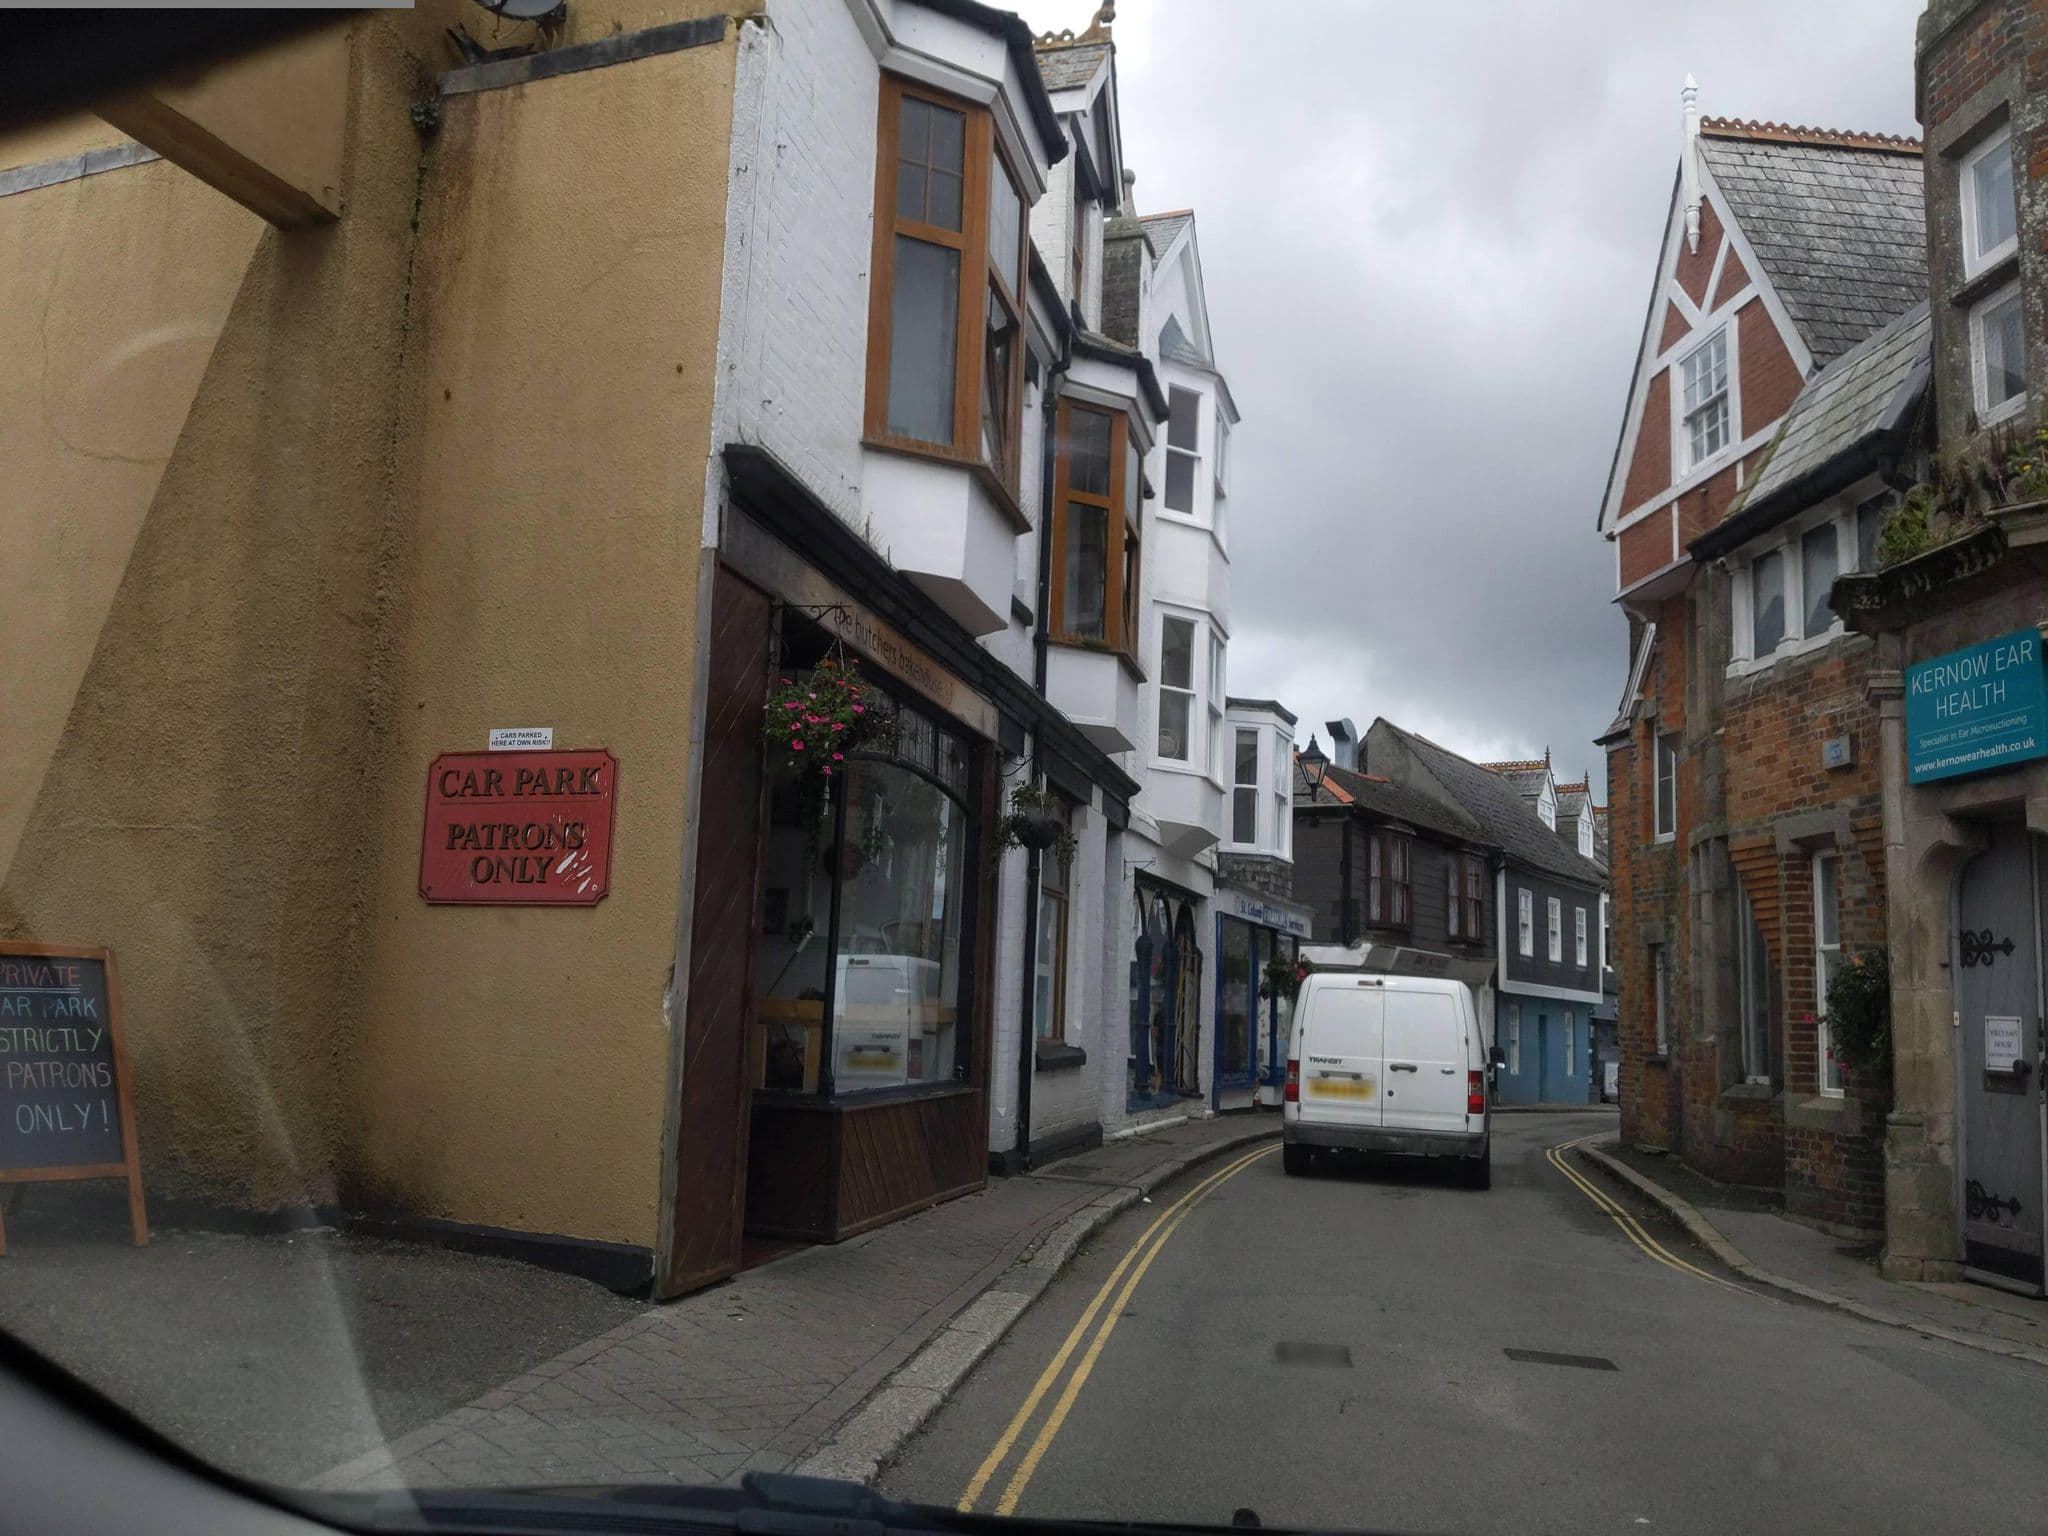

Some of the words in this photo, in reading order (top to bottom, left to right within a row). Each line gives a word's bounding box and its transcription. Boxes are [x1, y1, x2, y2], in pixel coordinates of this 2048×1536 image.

[855, 614, 897, 666] butchers
[1912, 653, 1989, 696] KERNOW
[1995, 639, 2033, 672] EAR
[1936, 679, 2006, 719] HEALTH
[1920, 733, 1949, 751] Specialist
[1950, 732, 1958, 740] in
[1958, 728, 1969, 739] Ear
[1970, 714, 2028, 736] Microsuctioning
[1914, 736, 2035, 773] www.kernowearhealth.co.uk
[439, 769, 504, 798] CAR
[513, 766, 601, 797] PARK
[446, 822, 586, 851] PATRONS
[471, 856, 554, 884] ONLY
[0, 997, 32, 1017] AR
[43, 996, 98, 1018] PARK
[0, 1027, 102, 1052] STRICTLY
[7, 1061, 112, 1089] PATRONS
[1308, 1056, 1344, 1065] TRANSIT
